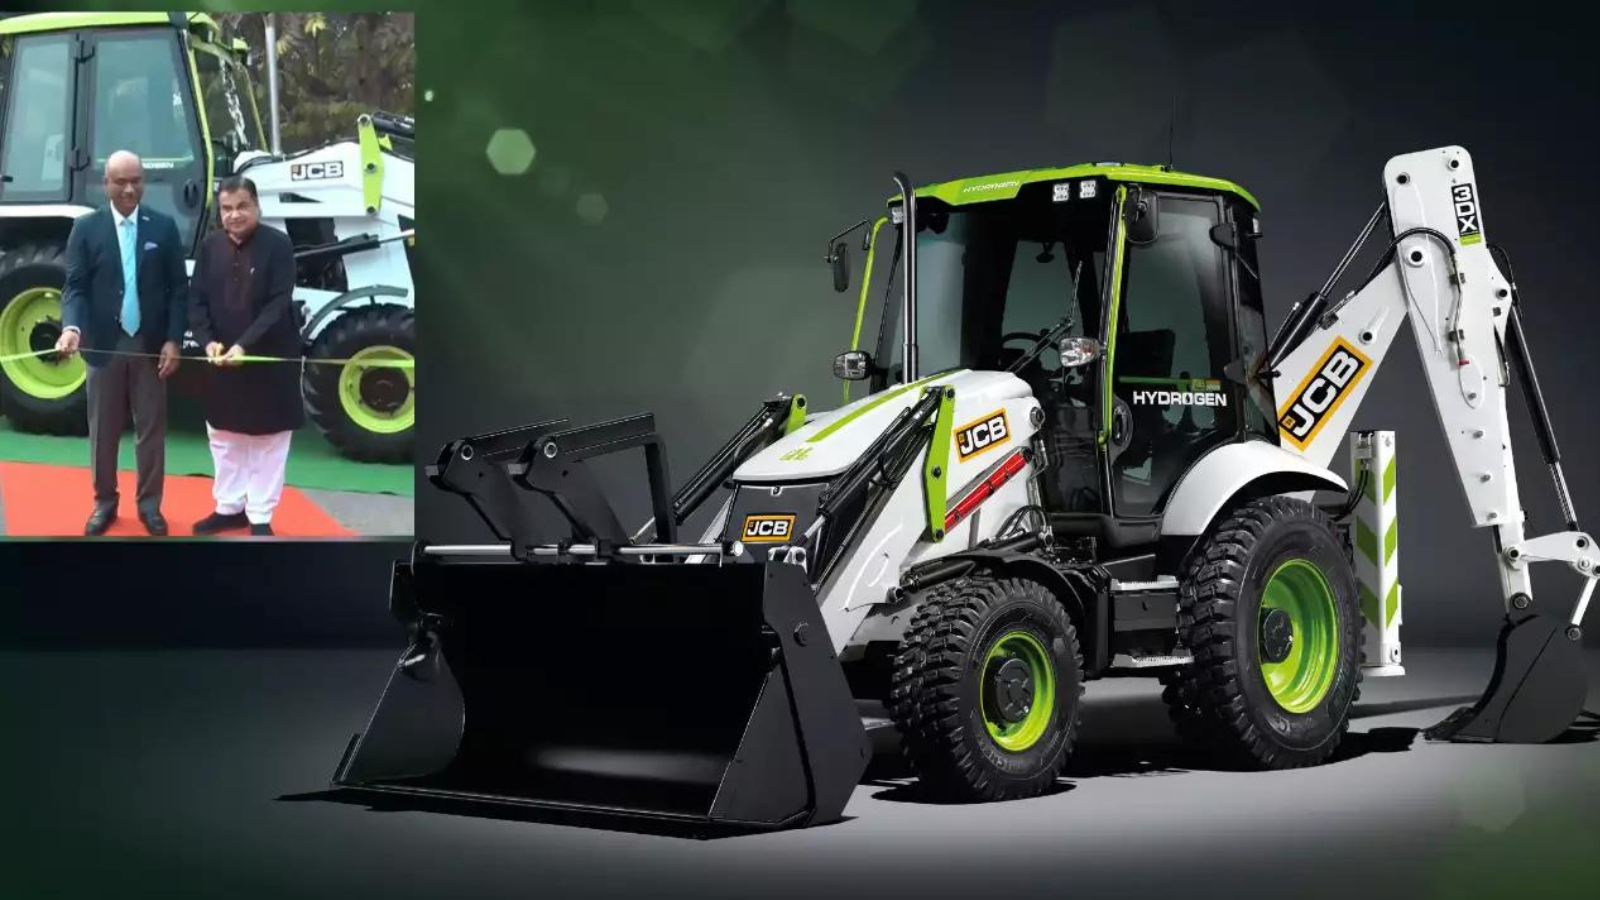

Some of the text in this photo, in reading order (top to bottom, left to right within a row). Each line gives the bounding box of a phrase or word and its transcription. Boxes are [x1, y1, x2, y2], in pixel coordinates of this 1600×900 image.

[292, 161, 343, 180] JCB
[1453, 185, 1478, 233] 3DX
[1132, 391, 1228, 406] HYDROGEN
[1291, 350, 1360, 437] JCB
[959, 416, 1007, 455] JCB
[747, 520, 789, 536] JCB
